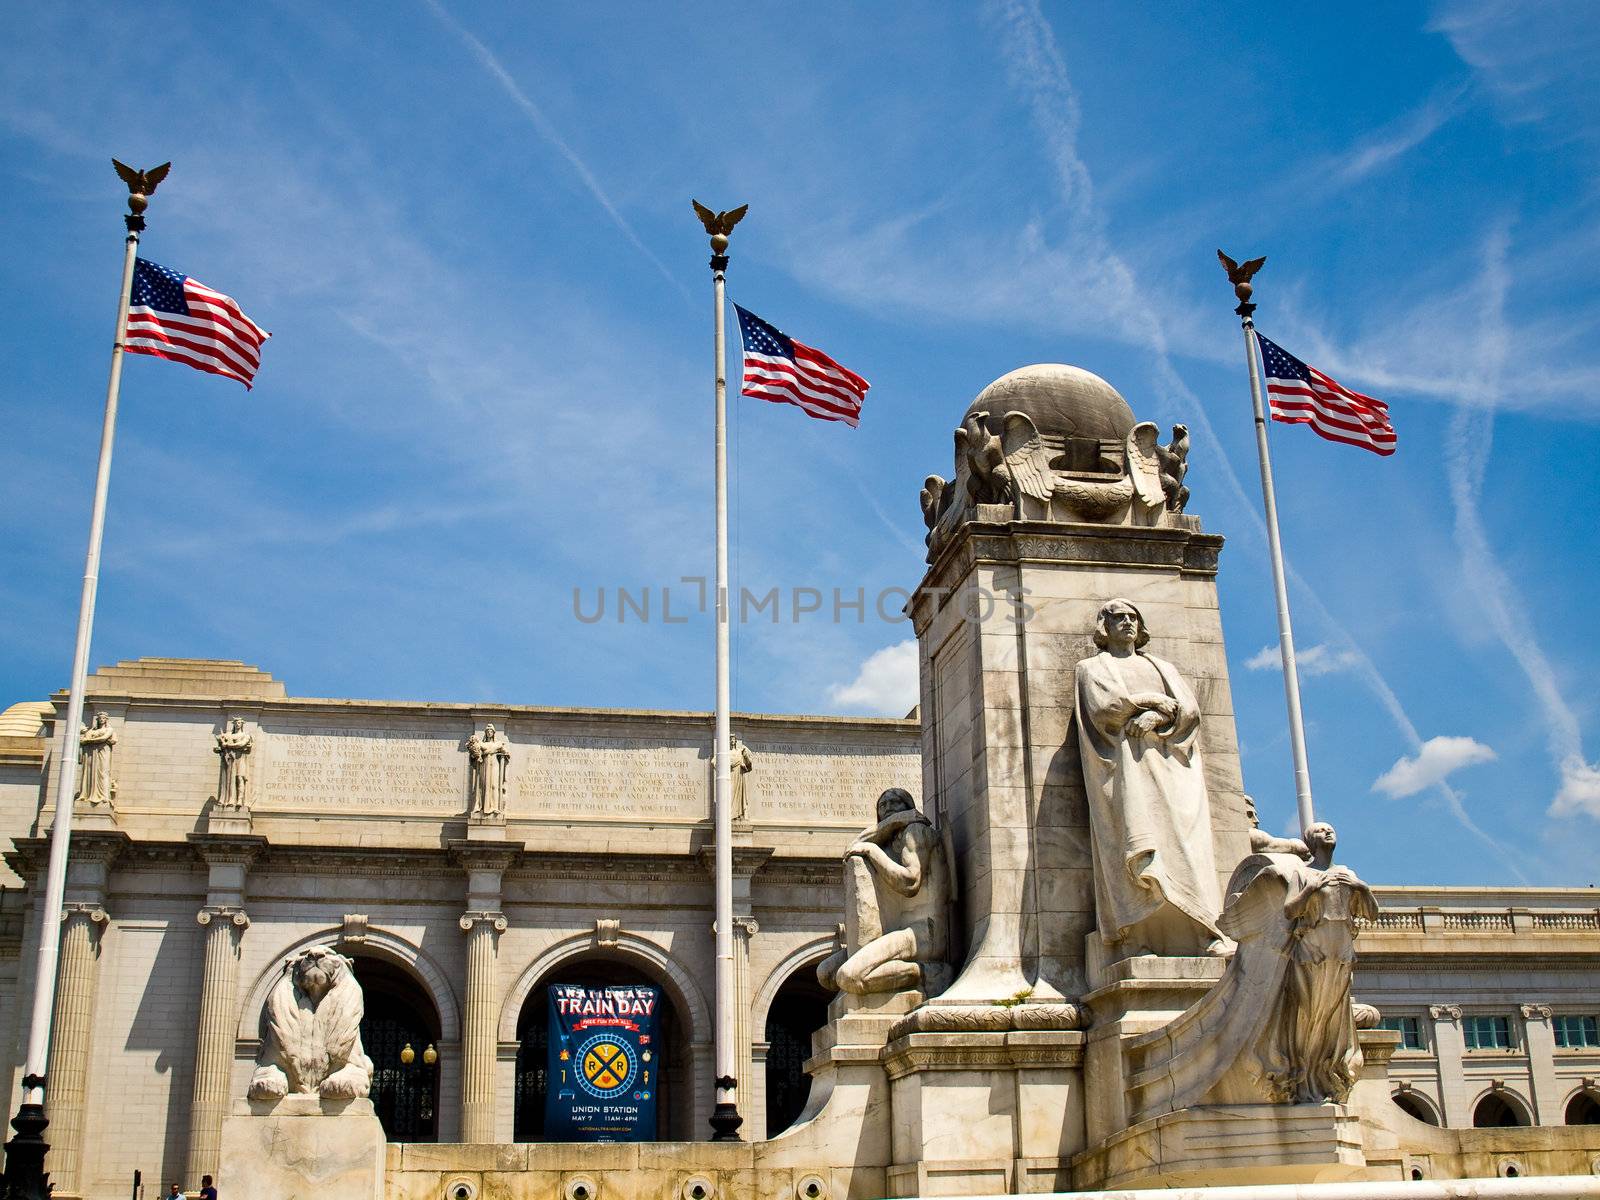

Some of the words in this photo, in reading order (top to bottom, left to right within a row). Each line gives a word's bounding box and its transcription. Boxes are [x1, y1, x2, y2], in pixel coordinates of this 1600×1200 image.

[558, 999, 615, 1015] TRAIN
[618, 999, 654, 1015] DAY
[588, 1061, 596, 1070] R
[616, 1061, 624, 1071] R
